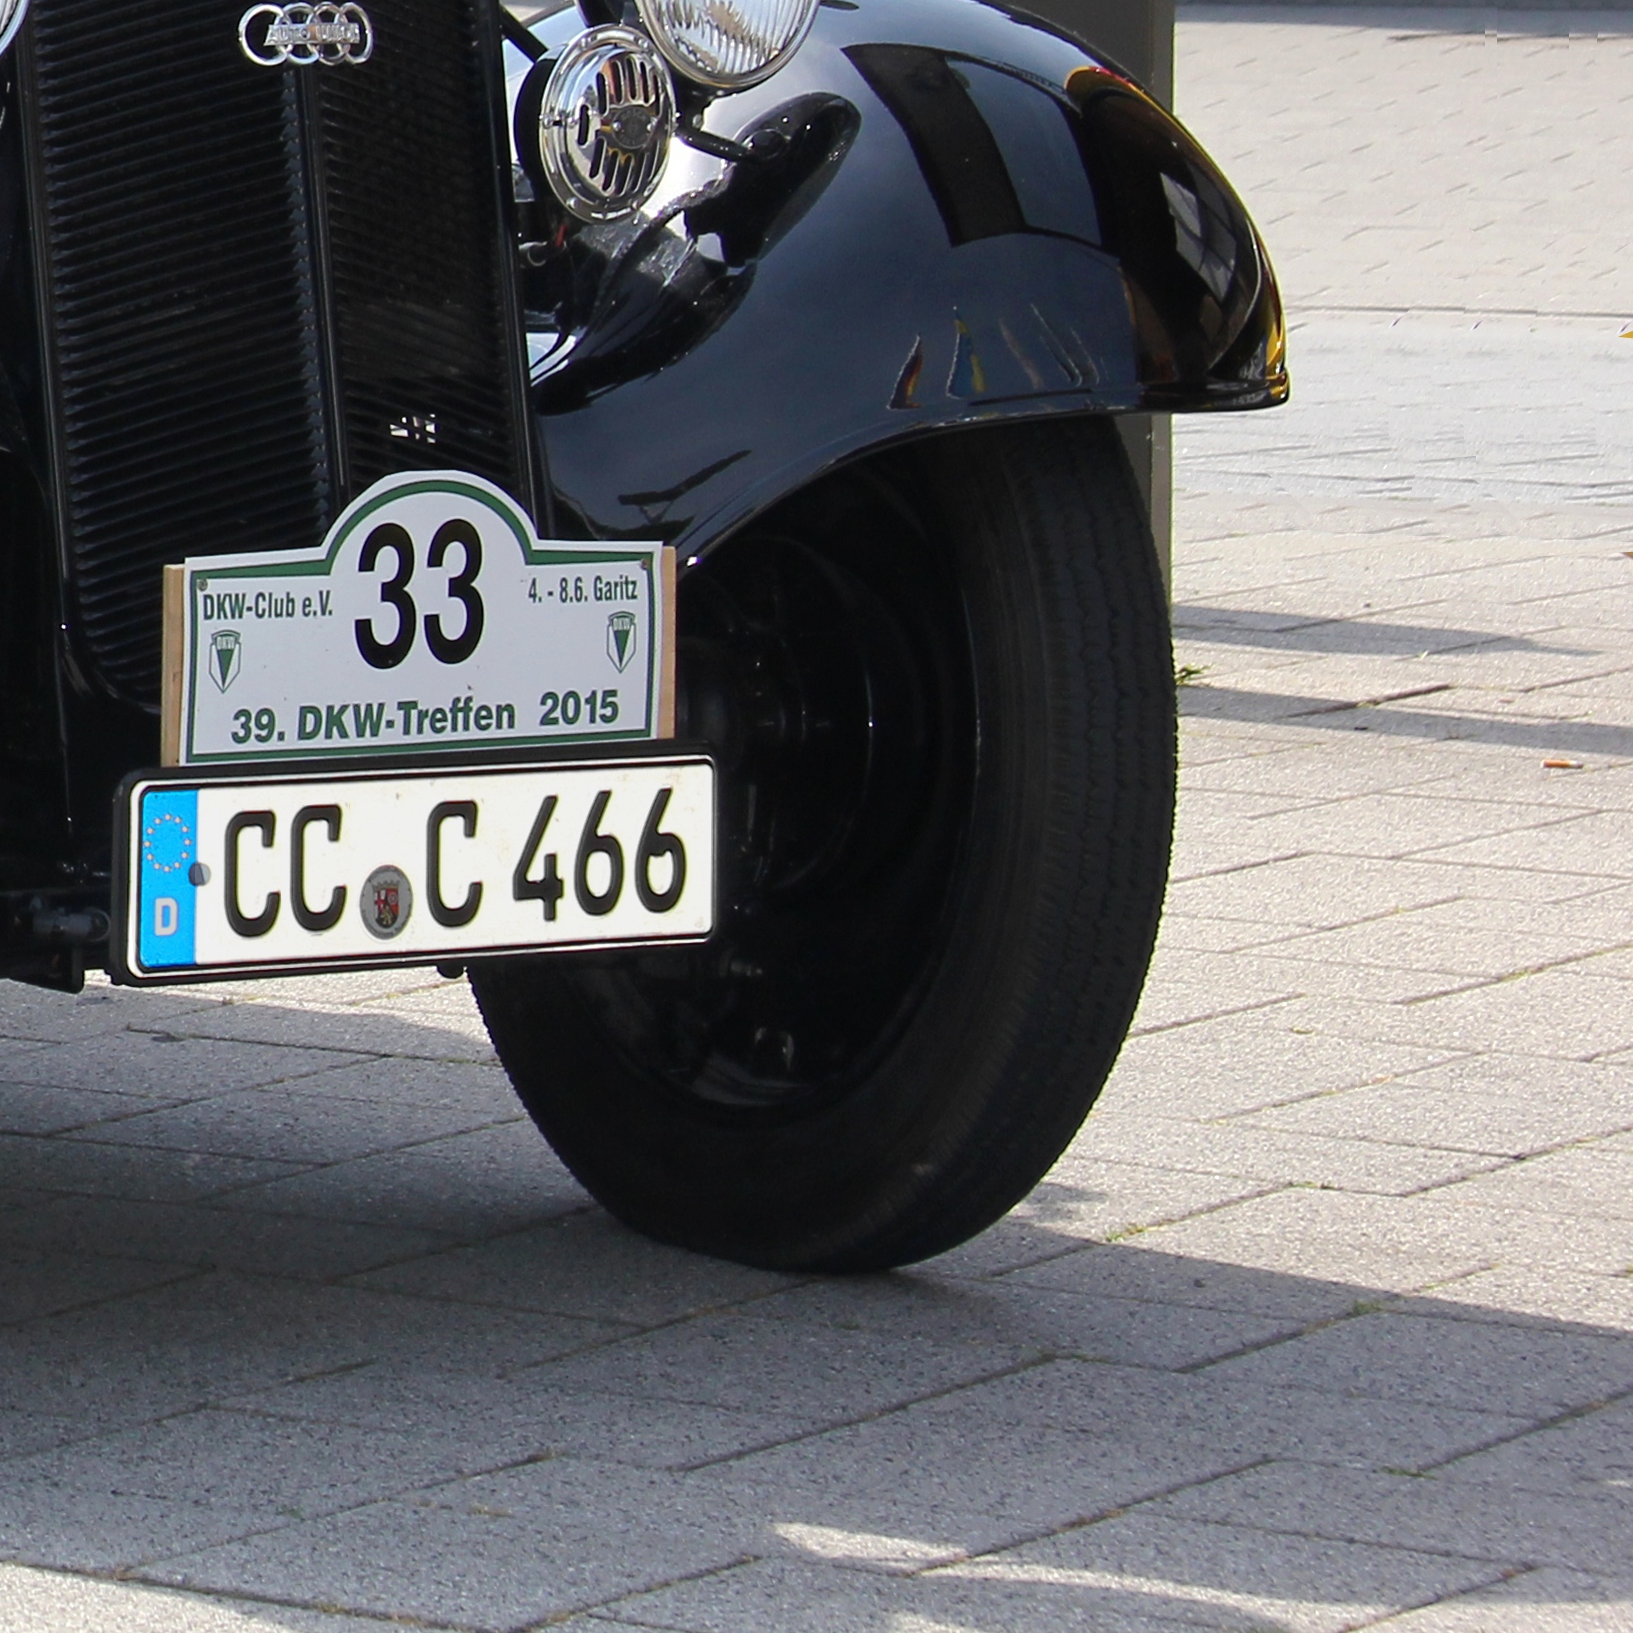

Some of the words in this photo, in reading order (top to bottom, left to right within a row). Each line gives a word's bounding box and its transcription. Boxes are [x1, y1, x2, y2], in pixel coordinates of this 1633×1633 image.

[270, 26, 310, 42] AUTO
[203, 591, 295, 621] DKW-Club
[302, 589, 333, 618] e.V.
[354, 517, 485, 670] 33
[528, 577, 542, 603] 4.
[559, 576, 588, 603] 8.6.
[593, 574, 638, 602] Garitz
[231, 706, 286, 744] 39.
[297, 697, 517, 742] DKW-Treffen
[539, 689, 619, 726] 2015
[223, 803, 347, 939] CC
[425, 799, 483, 929] C
[512, 787, 688, 922] 466
[154, 897, 179, 937] D
